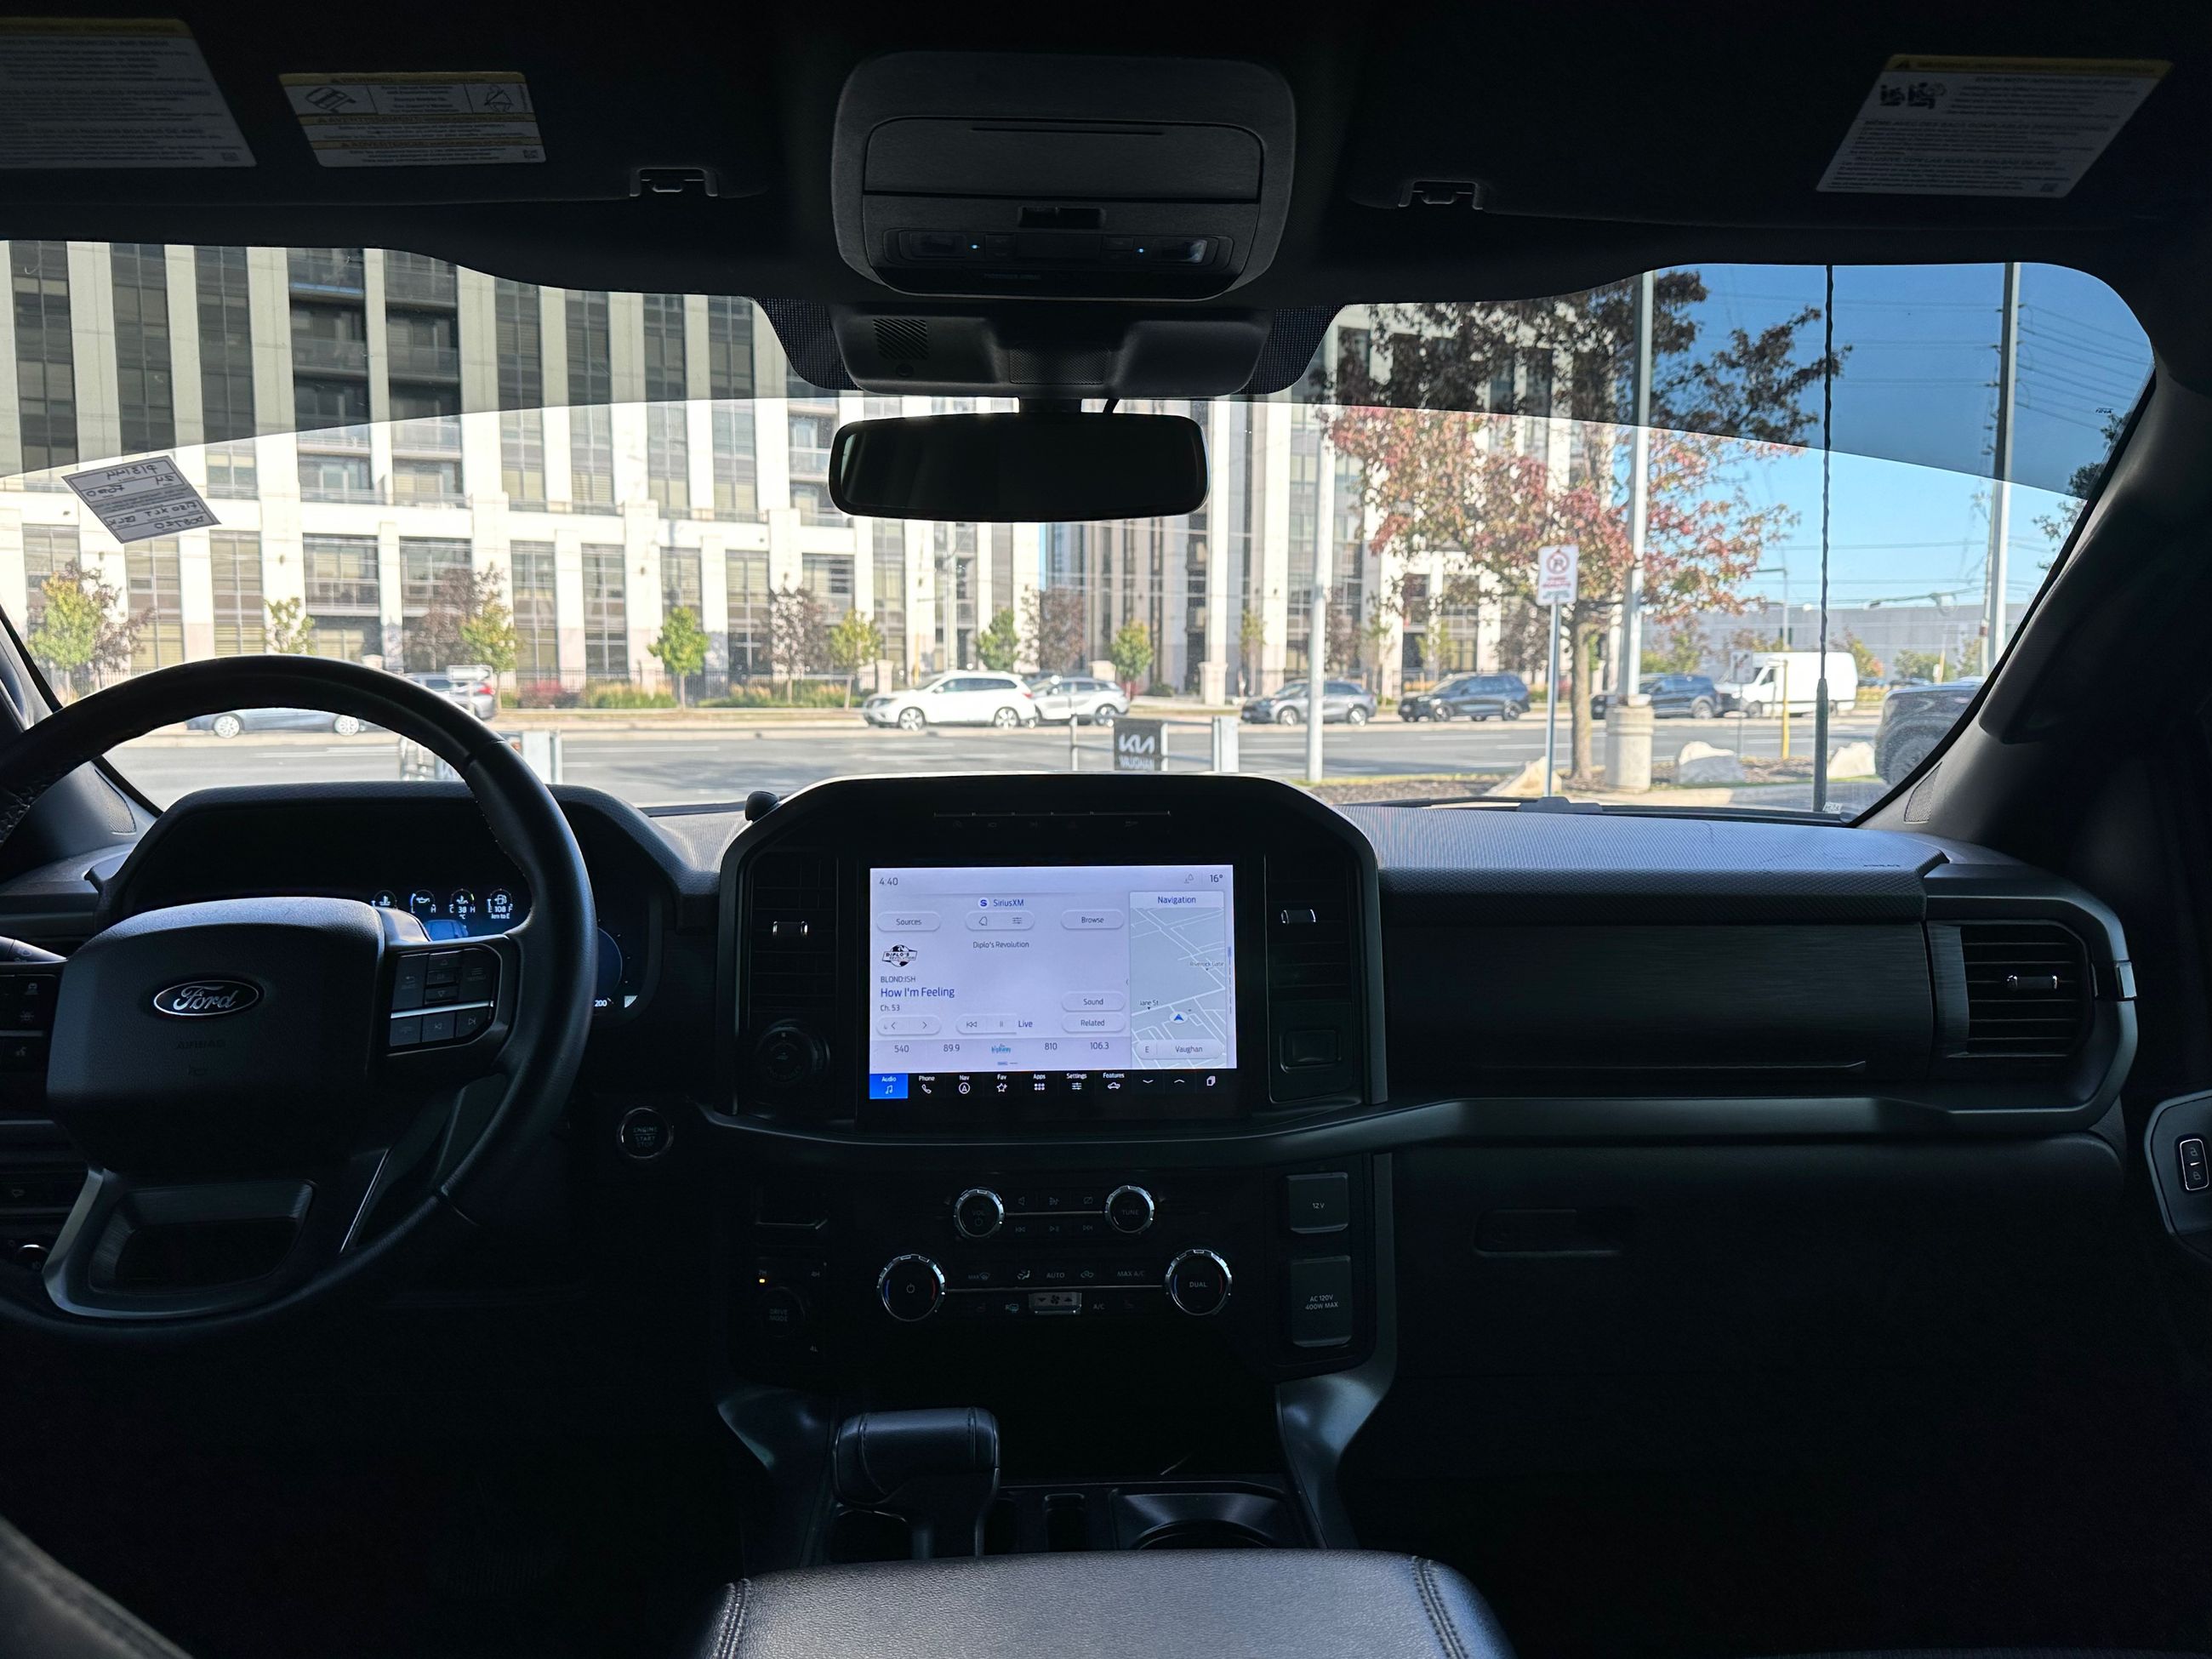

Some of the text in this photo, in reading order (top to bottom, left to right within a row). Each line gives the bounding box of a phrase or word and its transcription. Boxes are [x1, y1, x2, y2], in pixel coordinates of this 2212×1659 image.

[879, 877, 898, 886] 4:40
[1210, 874, 1223, 883] 16°
[993, 898, 1024, 907] SiriusXM
[1157, 896, 1196, 904] Navigation
[972, 941, 995, 949] Diplo's
[881, 987, 955, 998] How I'm Feeling
[173, 985, 239, 1011] Ford
[595, 999, 607, 1007] 200
[1090, 1041, 1109, 1050] 106.3
[1176, 1046, 1203, 1054] Vaughan
